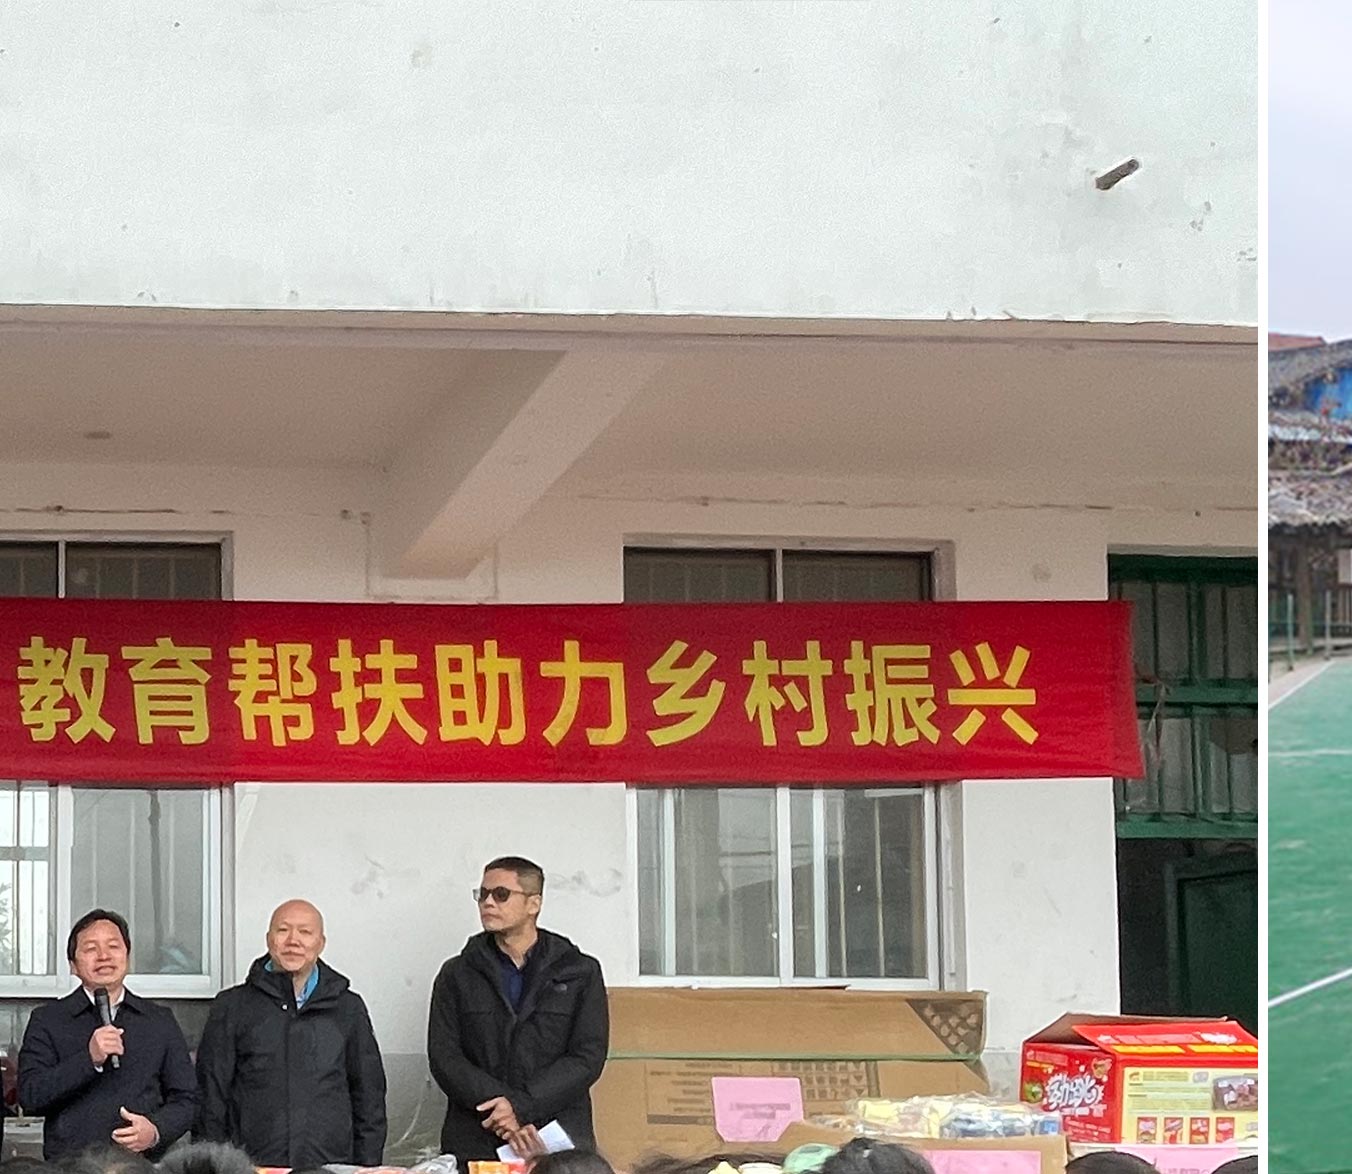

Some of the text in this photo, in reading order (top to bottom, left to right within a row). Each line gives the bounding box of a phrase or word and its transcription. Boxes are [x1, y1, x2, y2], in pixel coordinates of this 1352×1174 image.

[17, 636, 1040, 746] 教育帮扶助力乡村振兴
